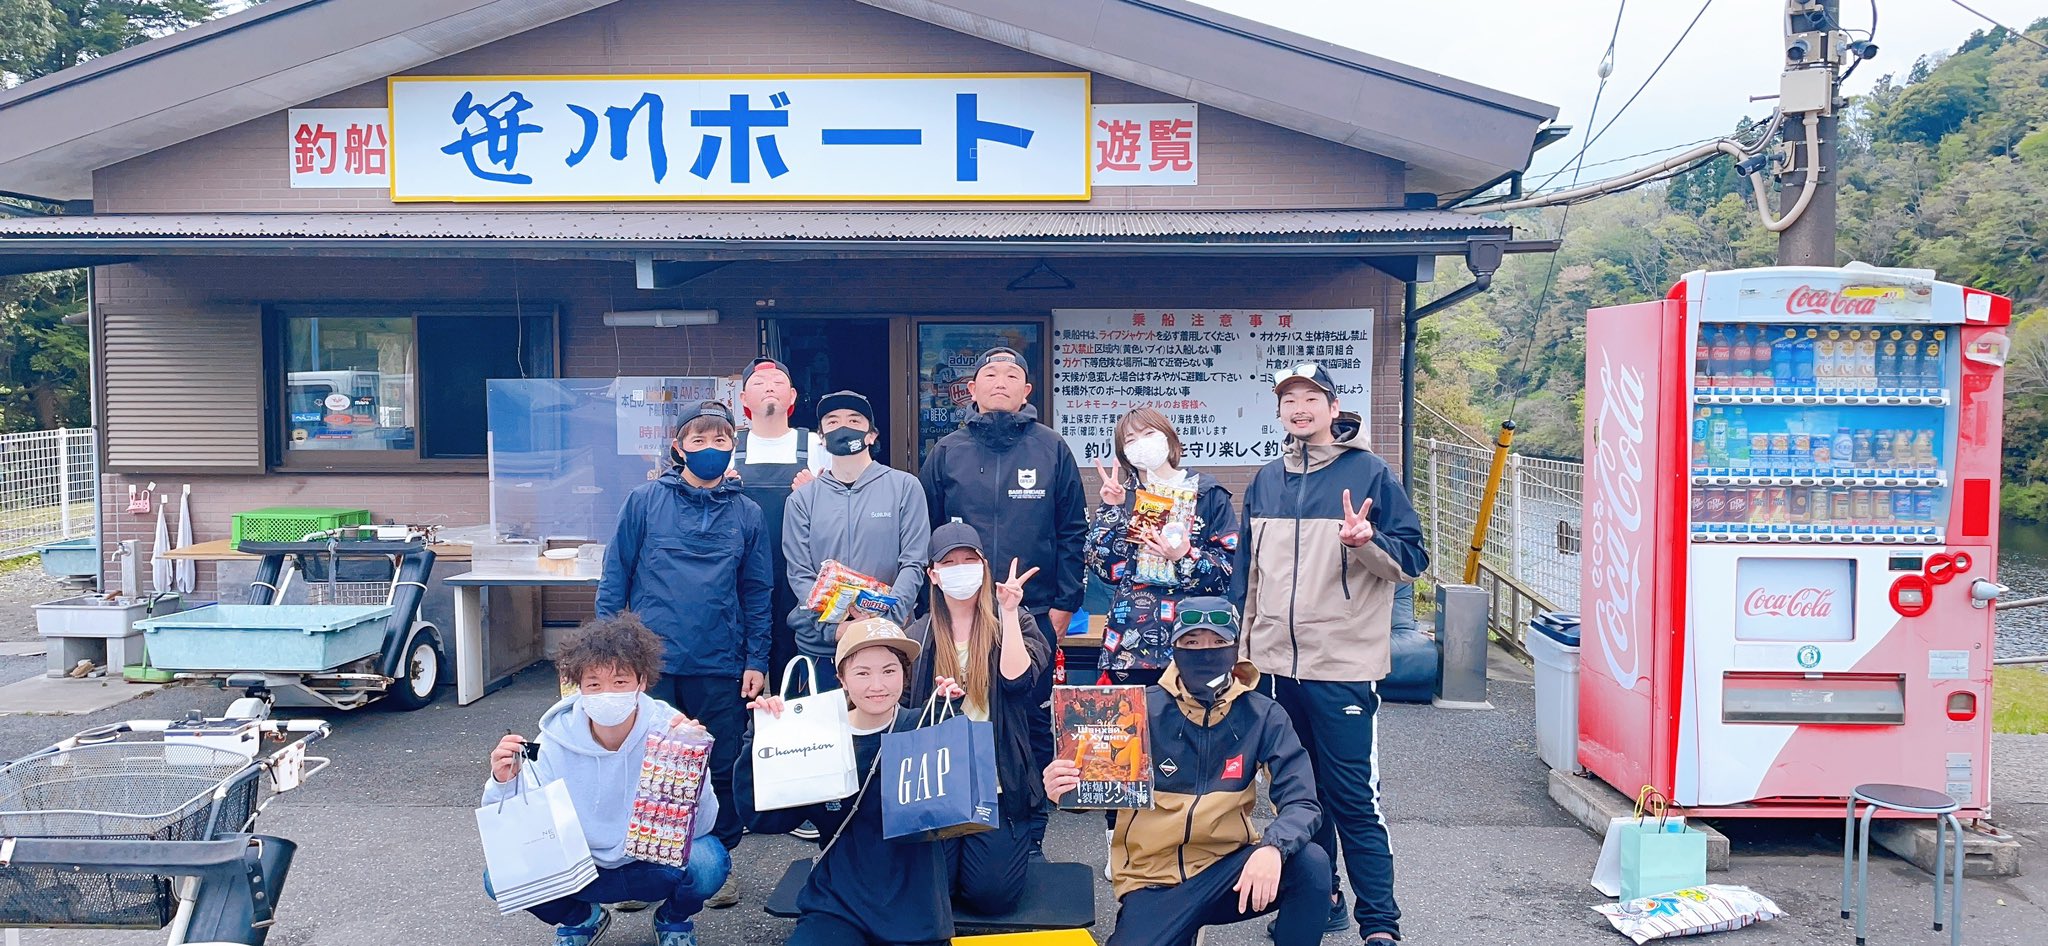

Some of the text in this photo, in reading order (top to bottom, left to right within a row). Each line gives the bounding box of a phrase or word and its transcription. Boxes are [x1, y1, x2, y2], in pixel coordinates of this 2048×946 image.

[294, 123, 387, 175] 釣船
[441, 91, 1034, 184] 笹川ボート
[1096, 118, 1193, 173] 遊覧
[1165, 414, 1215, 424] り海技免状の
[1743, 587, 1837, 617] Coca-Cola
[758, 742, 834, 759] Champion
[898, 747, 950, 805] GAP
